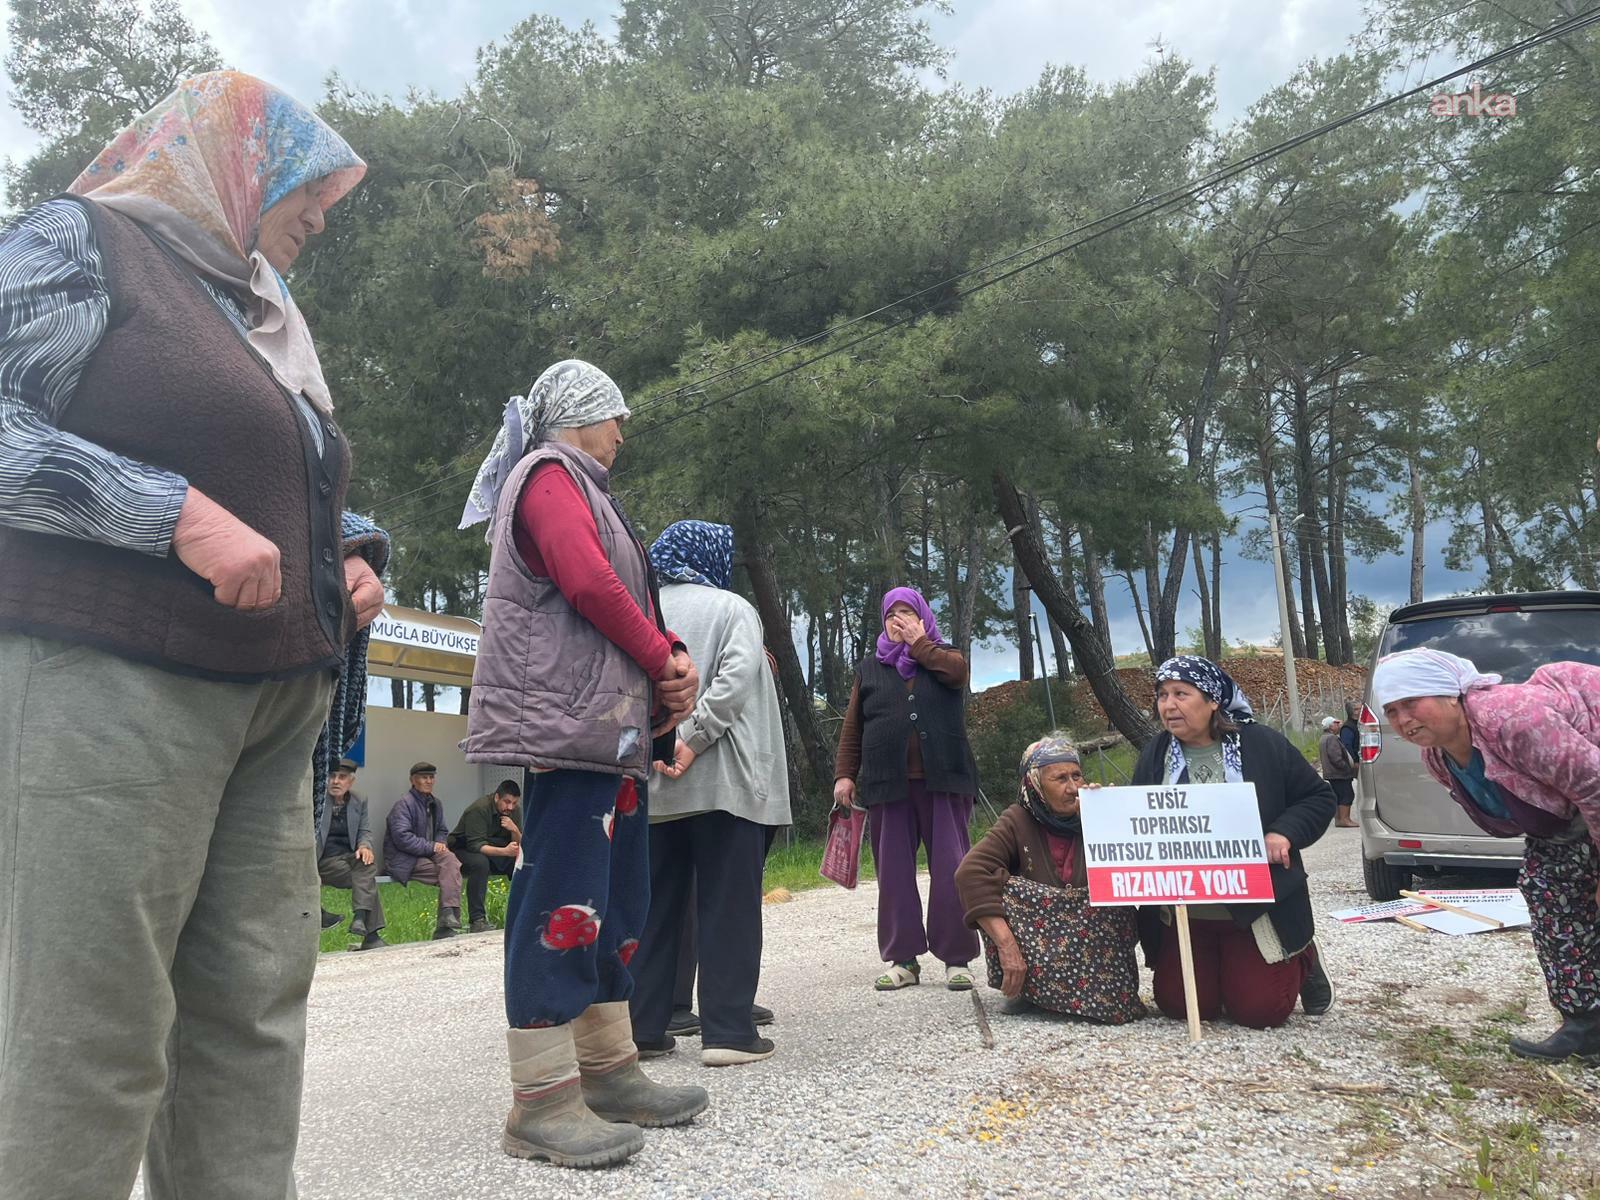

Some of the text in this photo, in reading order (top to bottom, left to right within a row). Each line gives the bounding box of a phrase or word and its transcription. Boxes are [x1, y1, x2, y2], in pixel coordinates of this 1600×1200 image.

[371, 621, 480, 653] MUĞLA BÜYÜKŞE
[1146, 788, 1189, 810] EVSİZ
[1130, 815, 1212, 835] TOPRAKSIZ
[1088, 839, 1263, 862] YURTSUZ BIRAKILMAYA
[1111, 869, 1248, 898] RIZAMIZ YOK!
